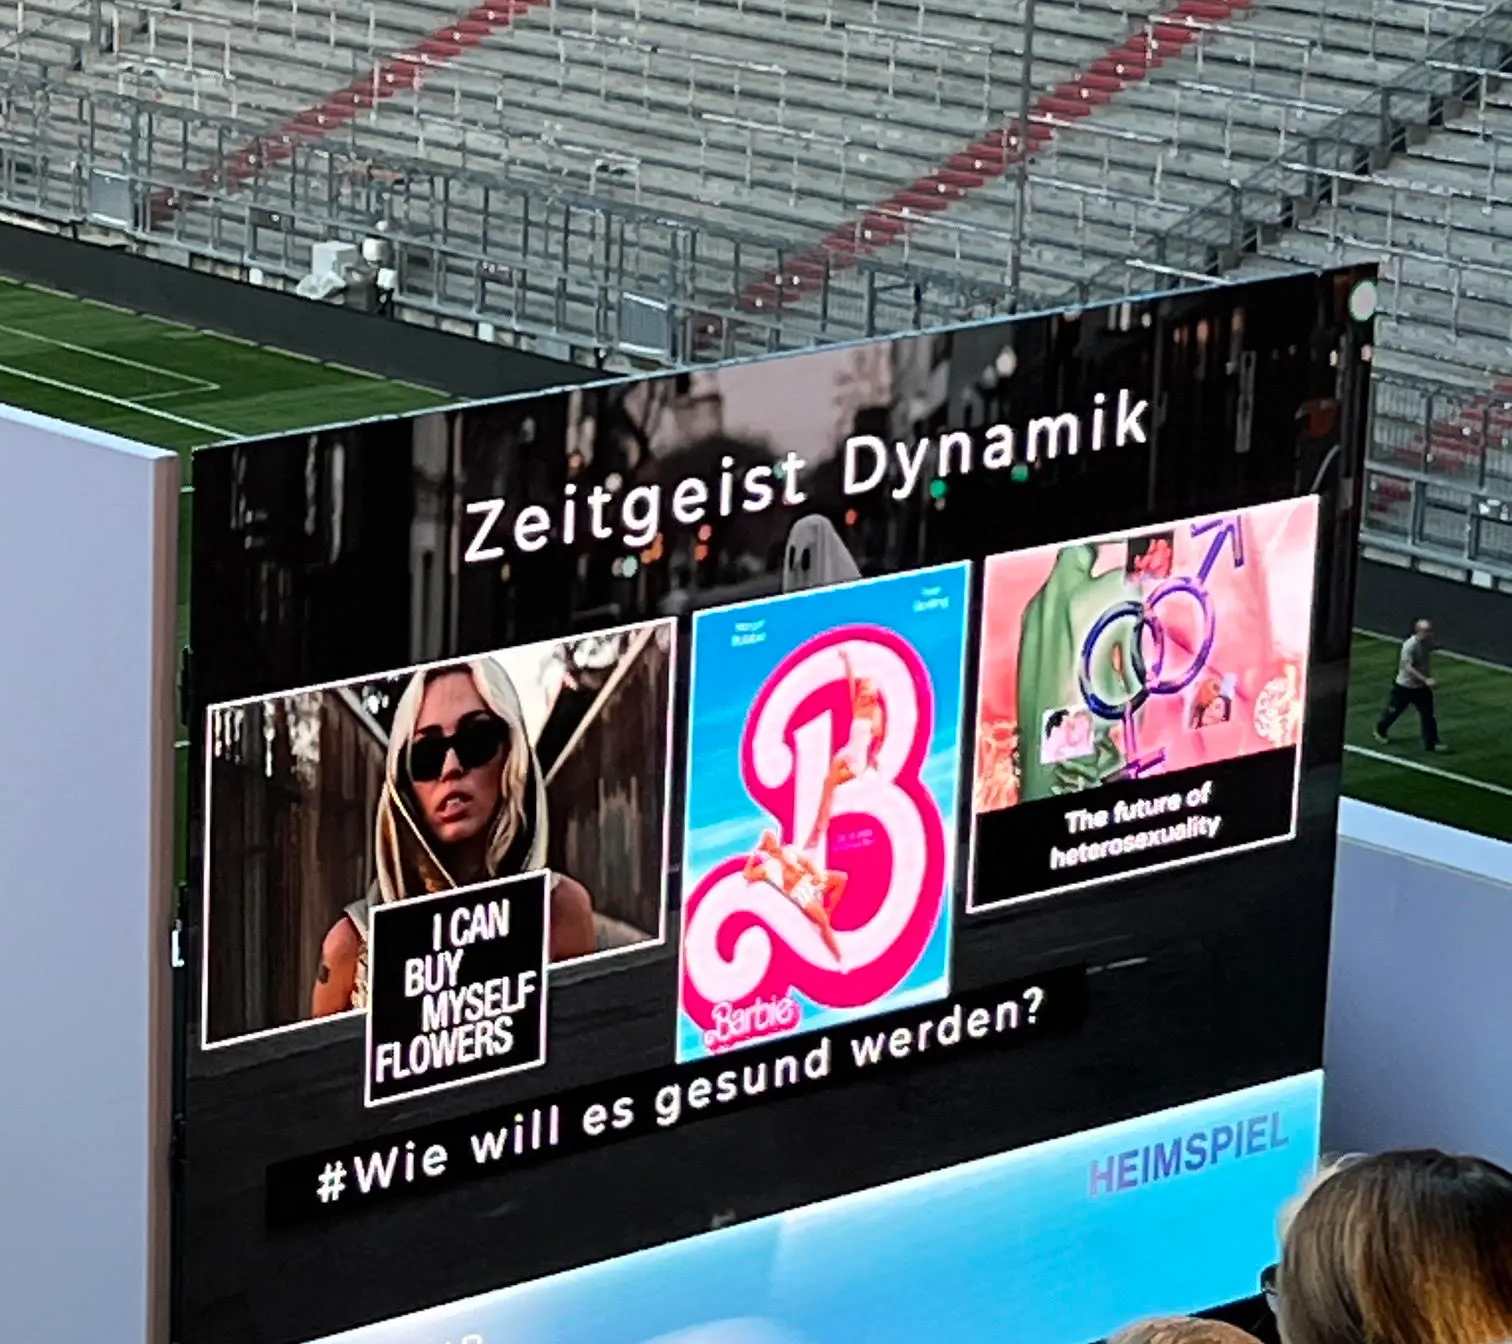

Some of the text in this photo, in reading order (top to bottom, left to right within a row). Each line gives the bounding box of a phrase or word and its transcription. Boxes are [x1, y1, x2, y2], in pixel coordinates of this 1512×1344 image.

[464, 387, 1149, 564] Zeitgeist Dynamik
[1064, 780, 1214, 834] The future of
[1049, 815, 1222, 870] heterosexuality
[433, 899, 510, 951] I CAN
[404, 949, 464, 997] BUY
[422, 970, 537, 1033] MYSELF
[375, 1016, 514, 1083] FLOWERS
[704, 994, 794, 1047] Barbie
[317, 986, 1046, 1204] #Wie will es gesund werden?
[1089, 1110, 1289, 1198] HEIMSPIEL
